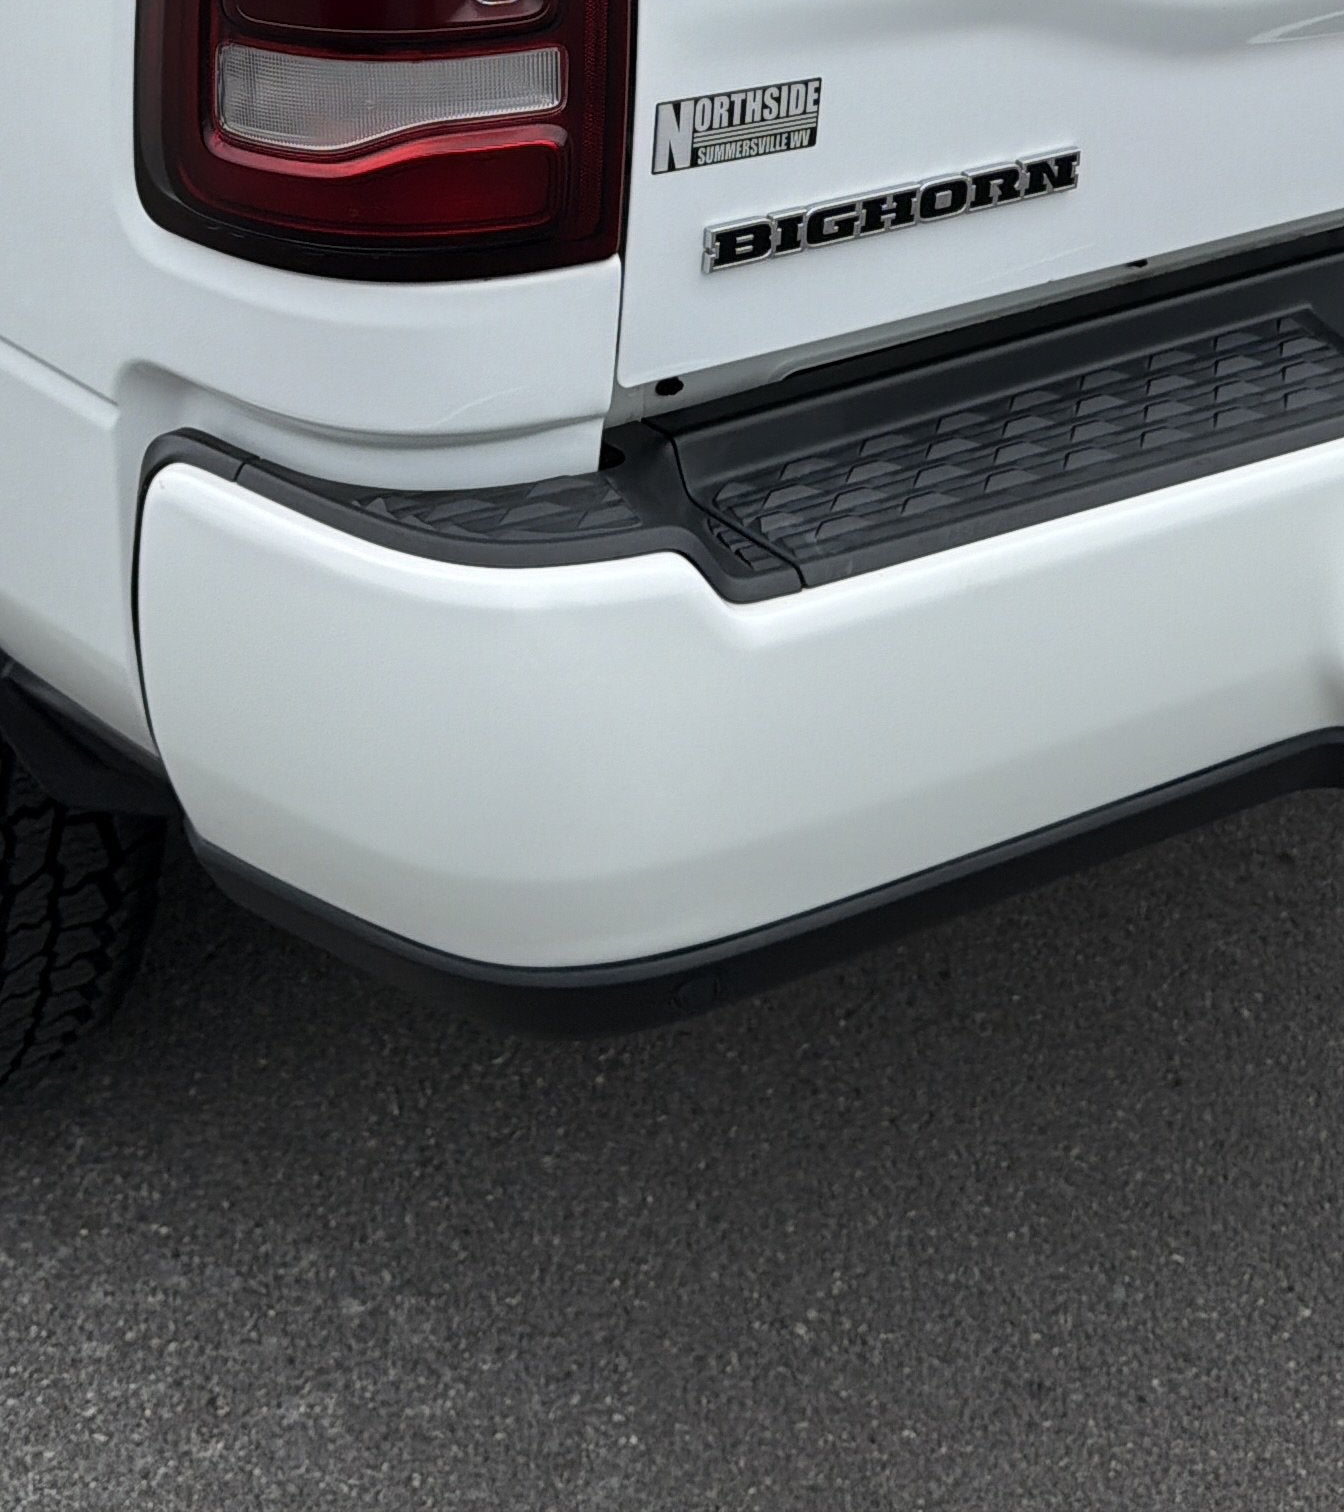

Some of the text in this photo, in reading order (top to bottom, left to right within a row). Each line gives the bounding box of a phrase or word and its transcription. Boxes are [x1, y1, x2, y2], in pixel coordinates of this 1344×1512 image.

[652, 80, 820, 173] NORTHSIDE
[697, 128, 811, 165] SUMMERSVILLE WV
[702, 146, 1081, 273] BIGHORN
